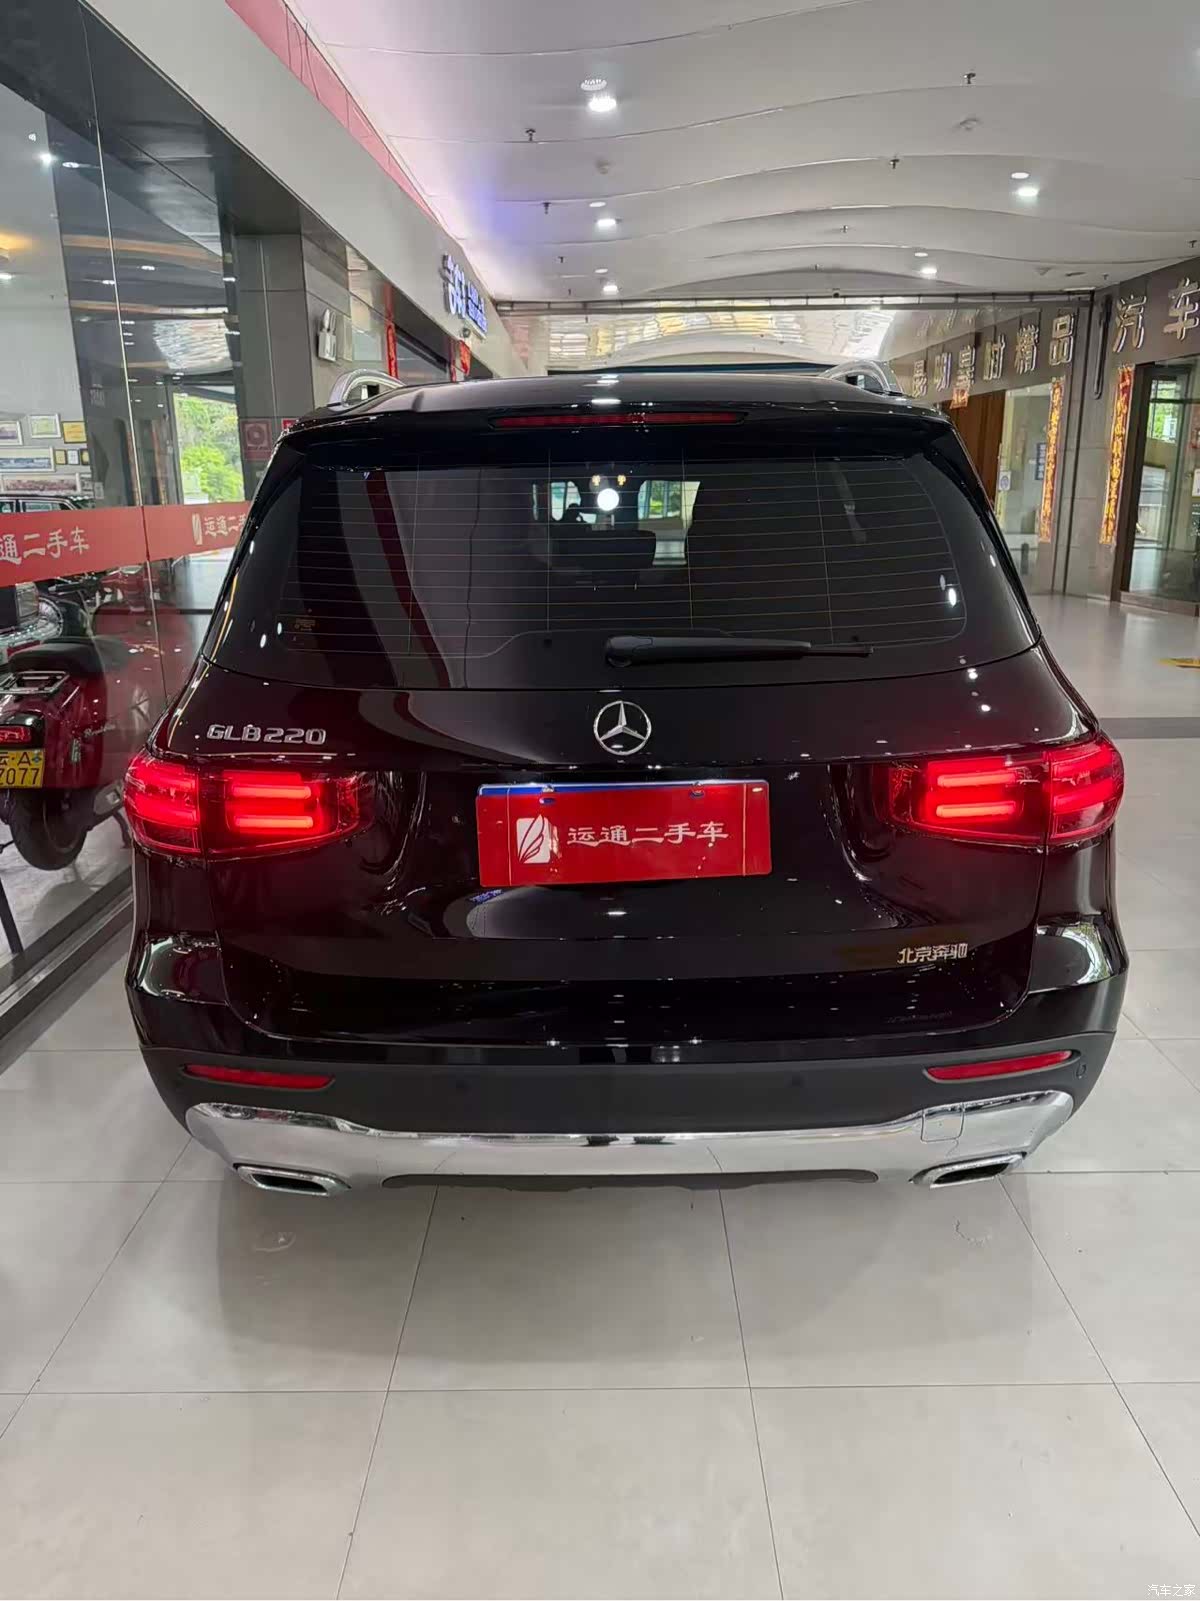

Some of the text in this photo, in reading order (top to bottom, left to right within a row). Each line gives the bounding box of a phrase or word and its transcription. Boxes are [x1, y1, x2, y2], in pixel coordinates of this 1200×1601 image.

[1113, 277, 1200, 353] 汽车
[567, 821, 729, 847] 运通二手车
[897, 943, 969, 963] 北京奔驰
